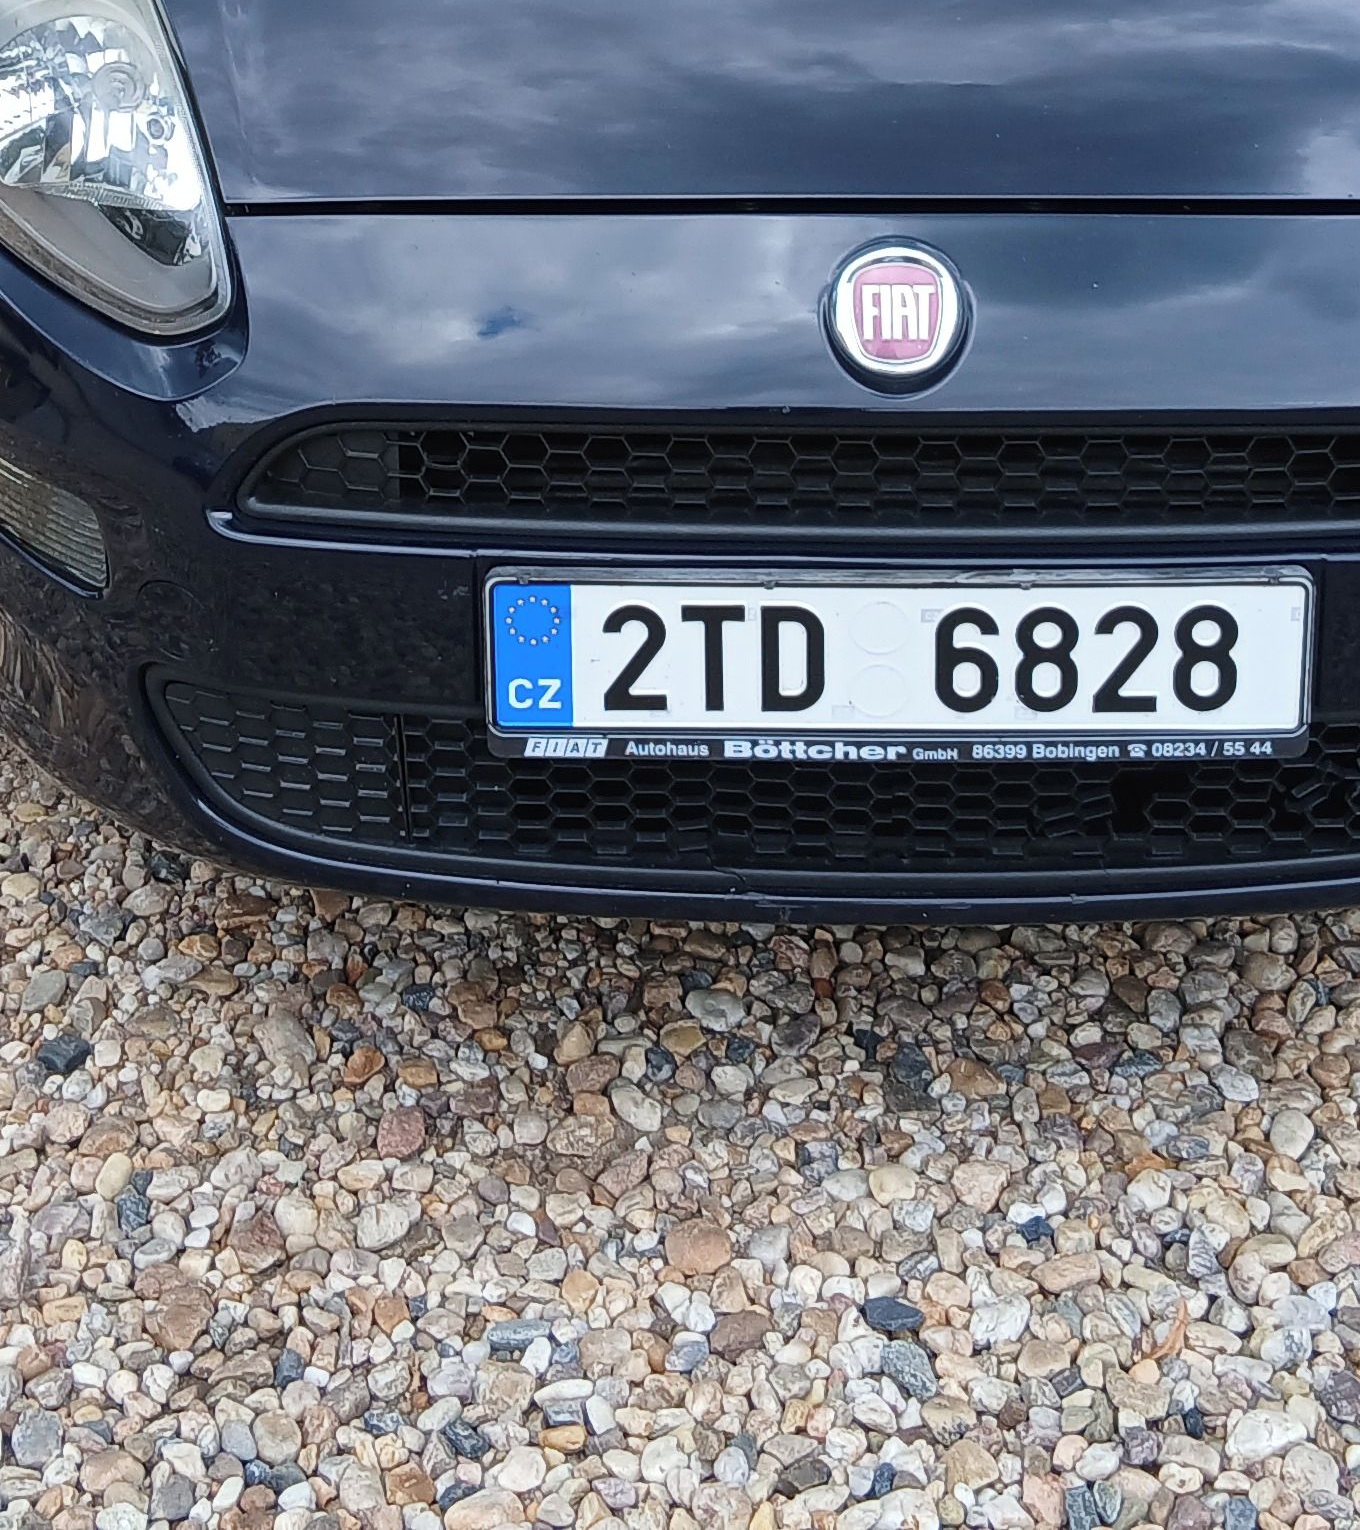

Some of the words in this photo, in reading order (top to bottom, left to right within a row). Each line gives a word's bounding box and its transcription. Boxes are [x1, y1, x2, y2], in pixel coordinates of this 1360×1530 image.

[860, 284, 935, 341] FIAT
[602, 604, 825, 712] 2TD
[934, 604, 1239, 713] 6828
[508, 678, 562, 709] CZ
[529, 739, 605, 756] FIAT
[624, 740, 710, 757] Autohaus
[723, 739, 907, 760] Böttcher
[912, 747, 958, 761] GmbH
[971, 744, 1027, 759] 86399
[1032, 743, 1120, 761] Bobingen
[1151, 741, 1206, 757] 08234
[1223, 740, 1245, 756] 55
[1249, 740, 1272, 756] 44
